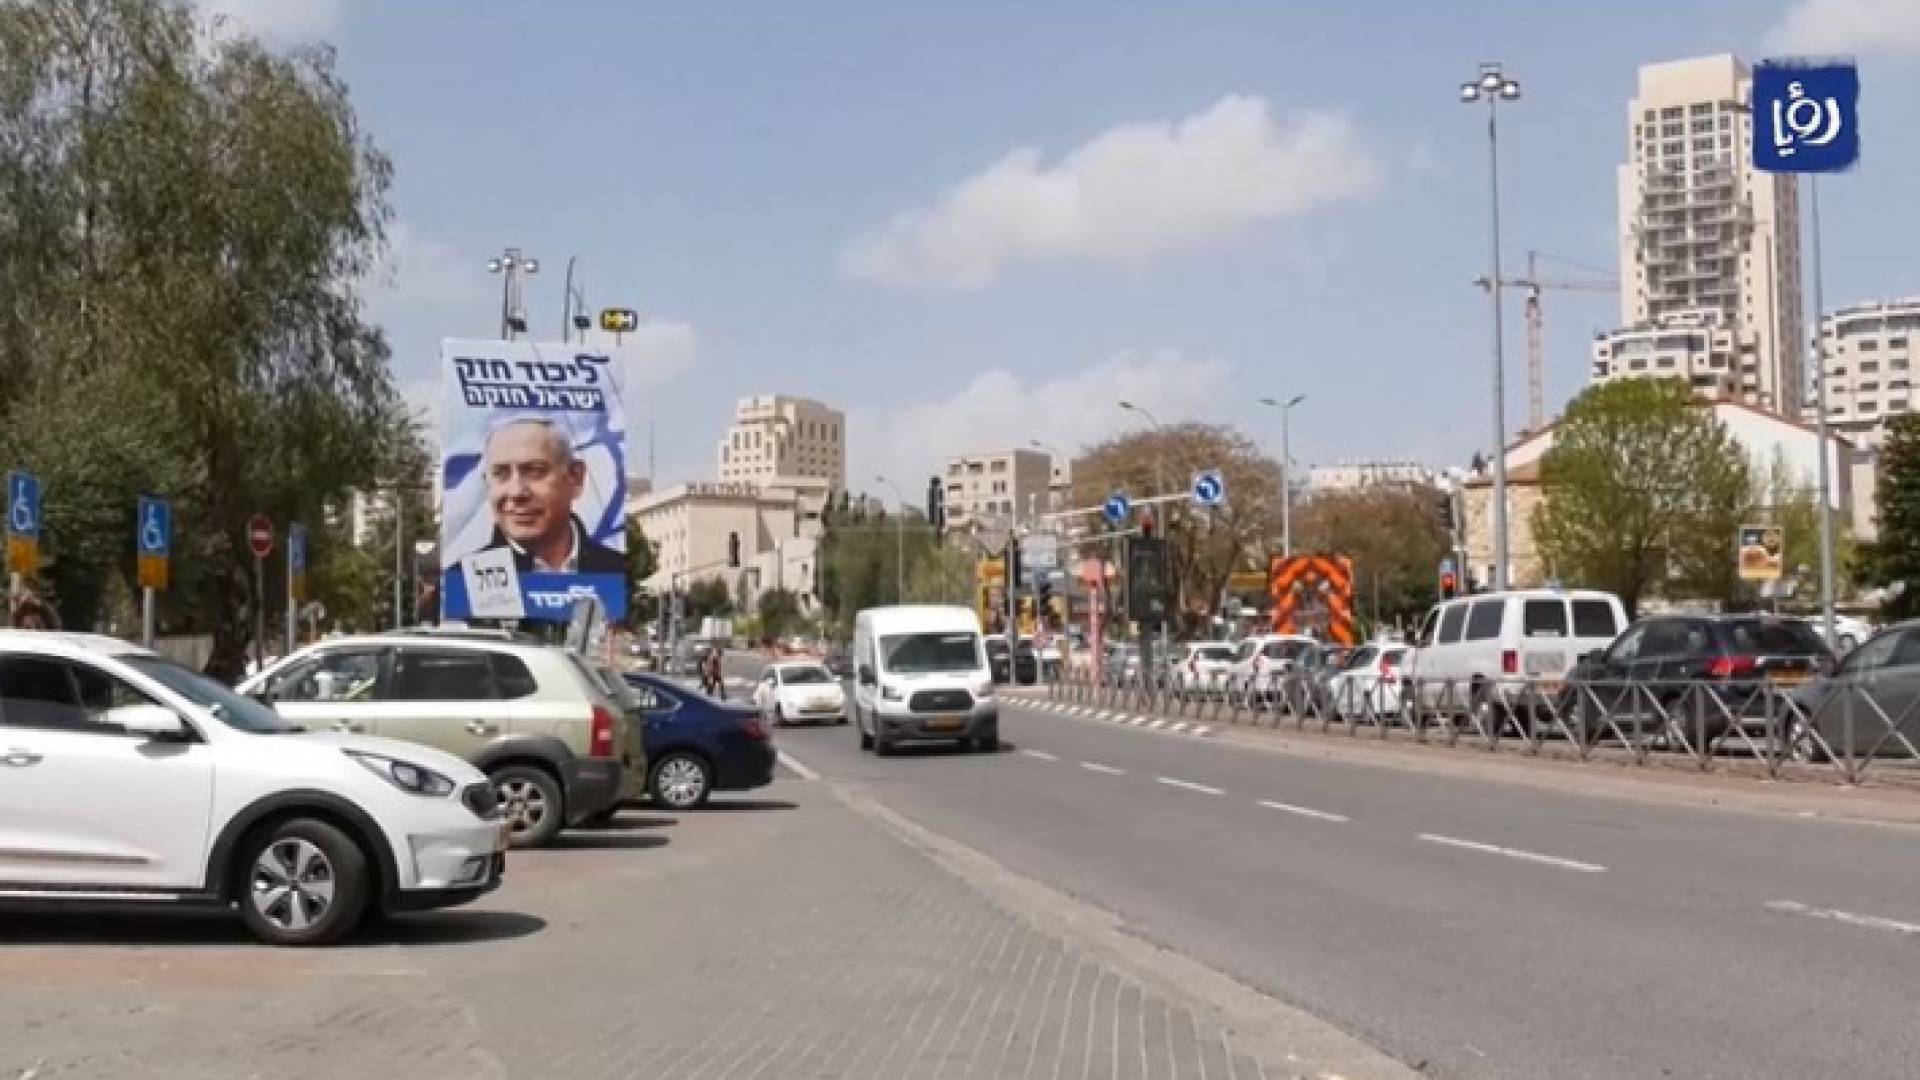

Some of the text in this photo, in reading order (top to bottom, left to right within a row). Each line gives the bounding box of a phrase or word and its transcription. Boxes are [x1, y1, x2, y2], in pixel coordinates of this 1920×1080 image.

[453, 354, 610, 388] ליכוד חזק
[467, 385, 602, 410] ישראל חזקה
[473, 560, 509, 591] מחל
